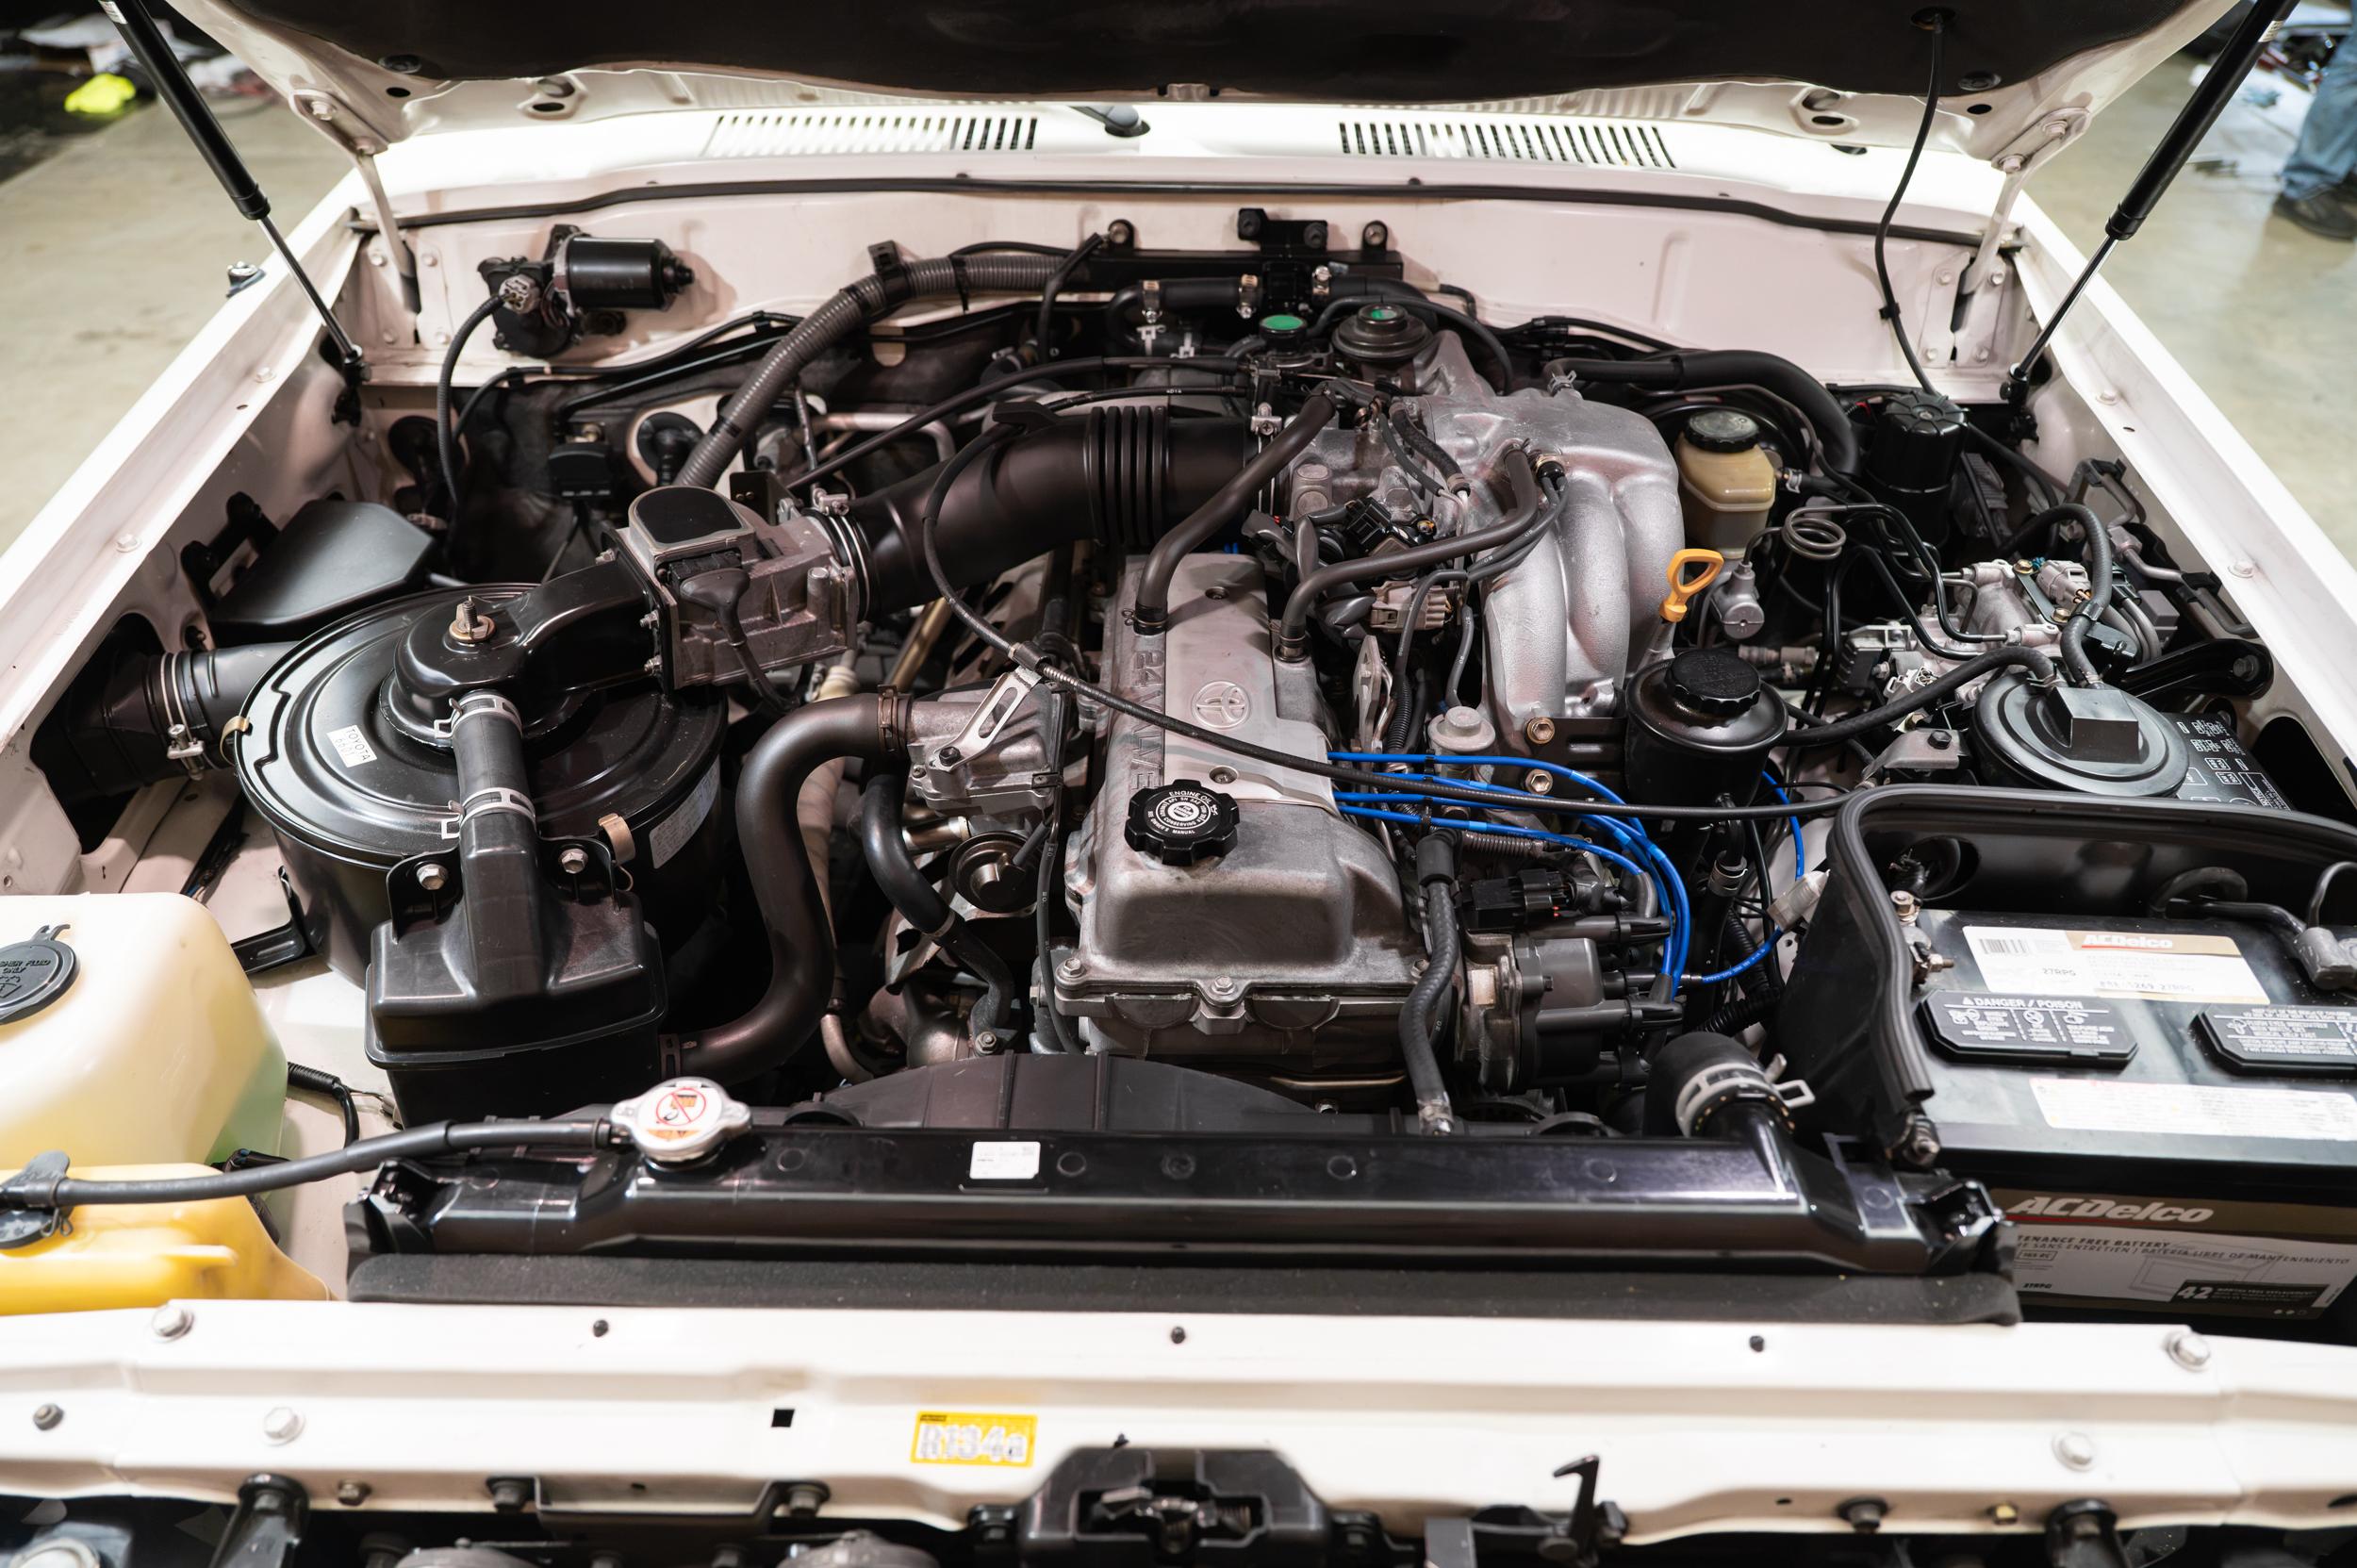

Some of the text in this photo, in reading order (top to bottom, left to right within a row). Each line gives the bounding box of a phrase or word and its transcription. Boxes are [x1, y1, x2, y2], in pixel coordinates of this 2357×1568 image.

[1133, 650, 1165, 687] 24
[346, 729, 371, 761] TOYOTA
[1169, 790, 1212, 805] ENGINE OIL
[2082, 934, 2173, 949] ACDelco
[1973, 997, 2026, 1008] DANGER
[2037, 999, 2085, 1010] POISON
[2005, 1197, 2215, 1223] ACDelco
[2080, 1237, 2111, 1246] FREE
[2114, 1239, 2171, 1248] BATTERY
[2247, 1253, 2350, 1264] MANTENIMIENTO
[2176, 1285, 2215, 1299] 42
[916, 1423, 1028, 1462] R134a
